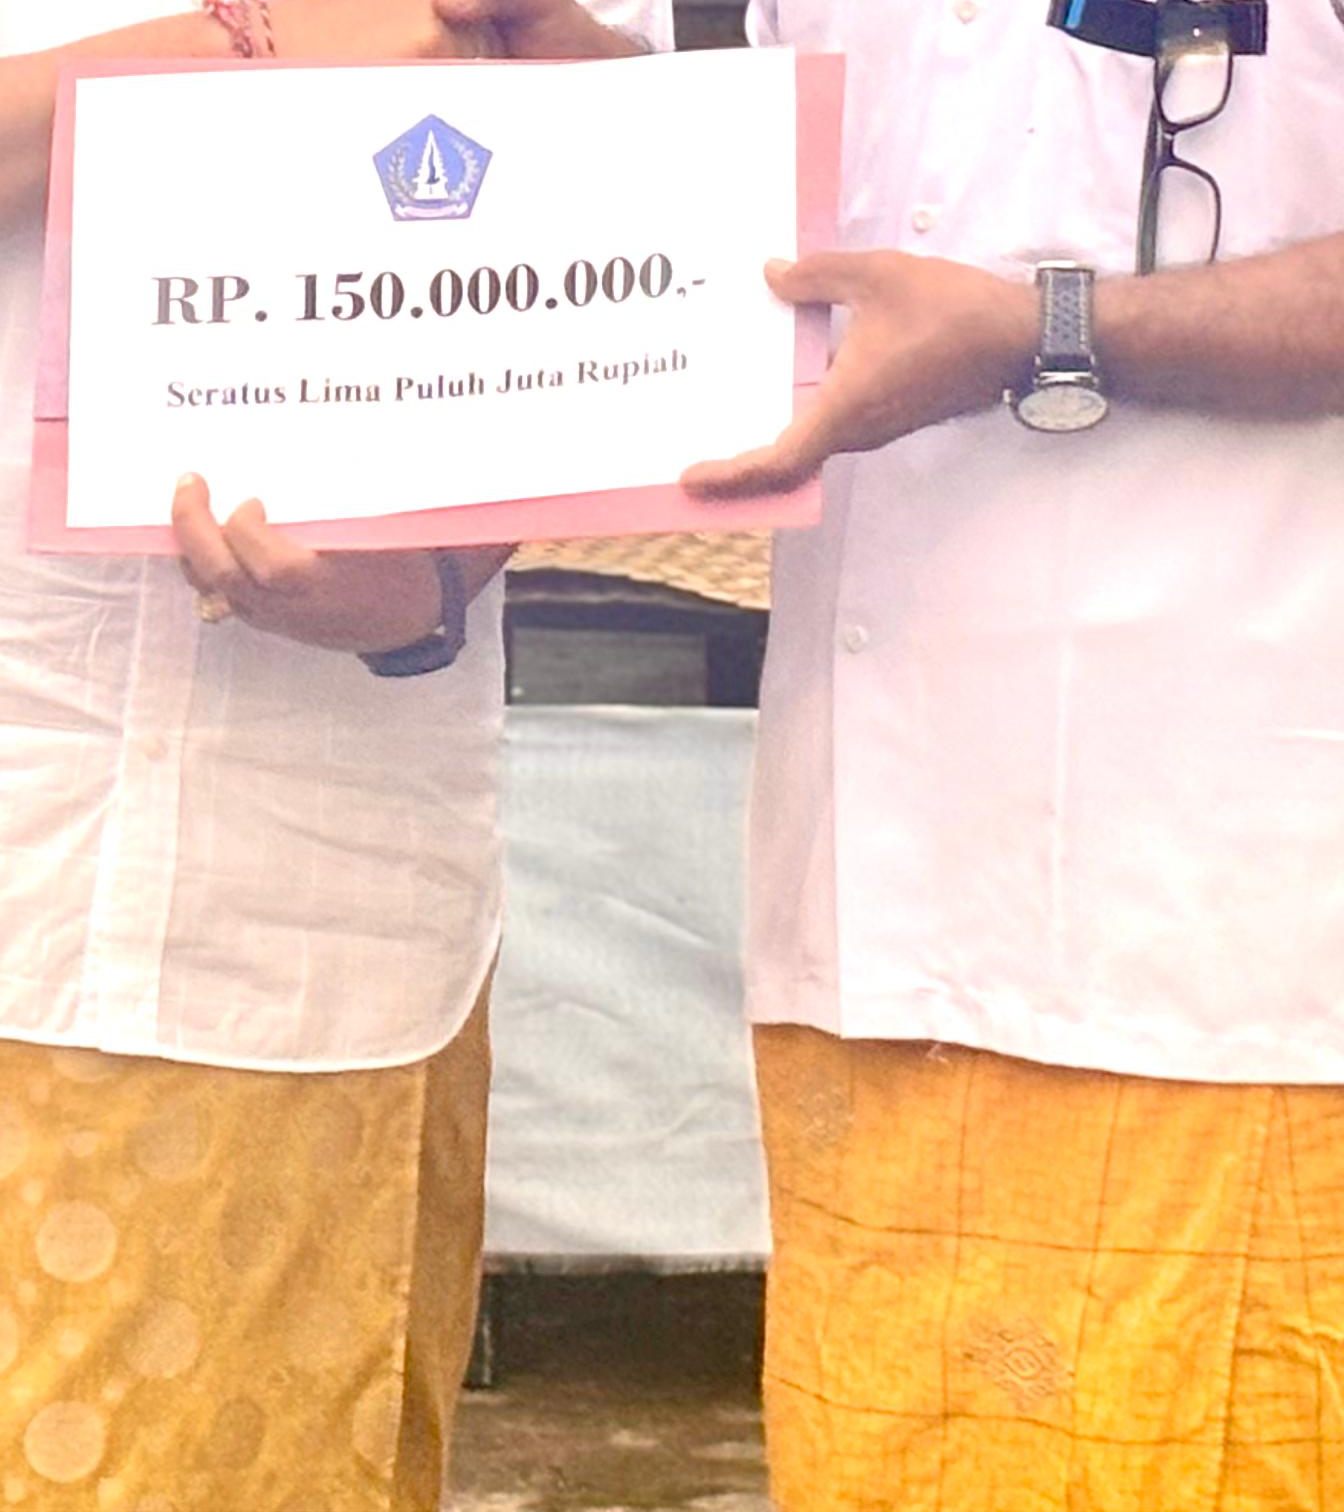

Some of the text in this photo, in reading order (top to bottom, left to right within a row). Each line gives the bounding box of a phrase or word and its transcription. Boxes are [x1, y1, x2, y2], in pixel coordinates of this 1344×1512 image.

[152, 252, 706, 326] RP. 150.000.000,-
[166, 348, 689, 408] Seratus Lima Puluh Juta Rupiah
